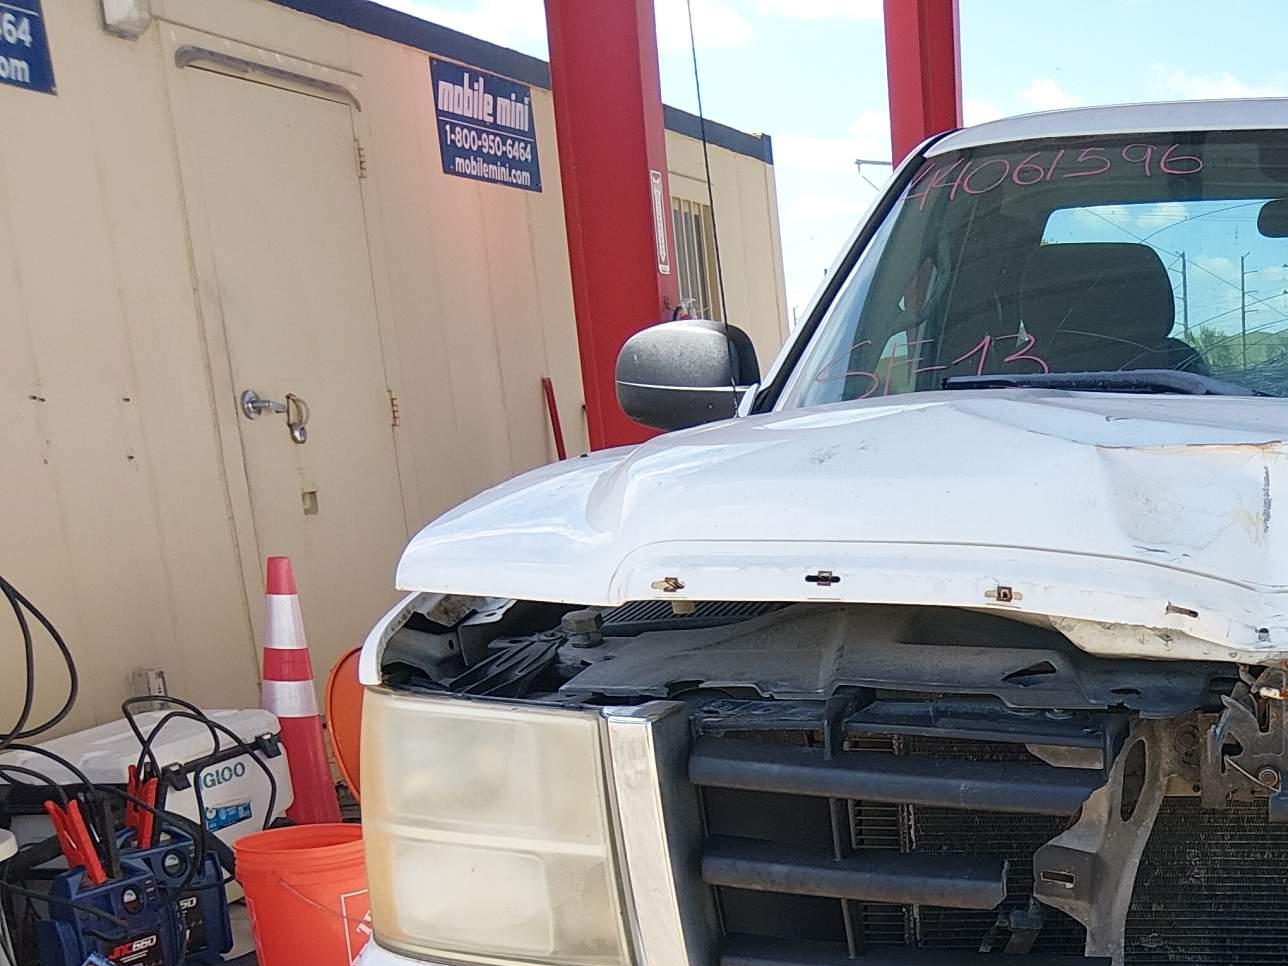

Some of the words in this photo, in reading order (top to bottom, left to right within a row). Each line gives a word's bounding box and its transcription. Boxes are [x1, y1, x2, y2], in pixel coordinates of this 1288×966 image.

[0, 12, 32, 48] 64
[438, 72, 494, 123] mobile
[496, 93, 530, 131] mini
[445, 124, 532, 163] 1-800-950-6464
[455, 155, 531, 187] mobilemini.com
[903, 143, 1203, 210] 44061596
[202, 762, 246, 788] GLOO
